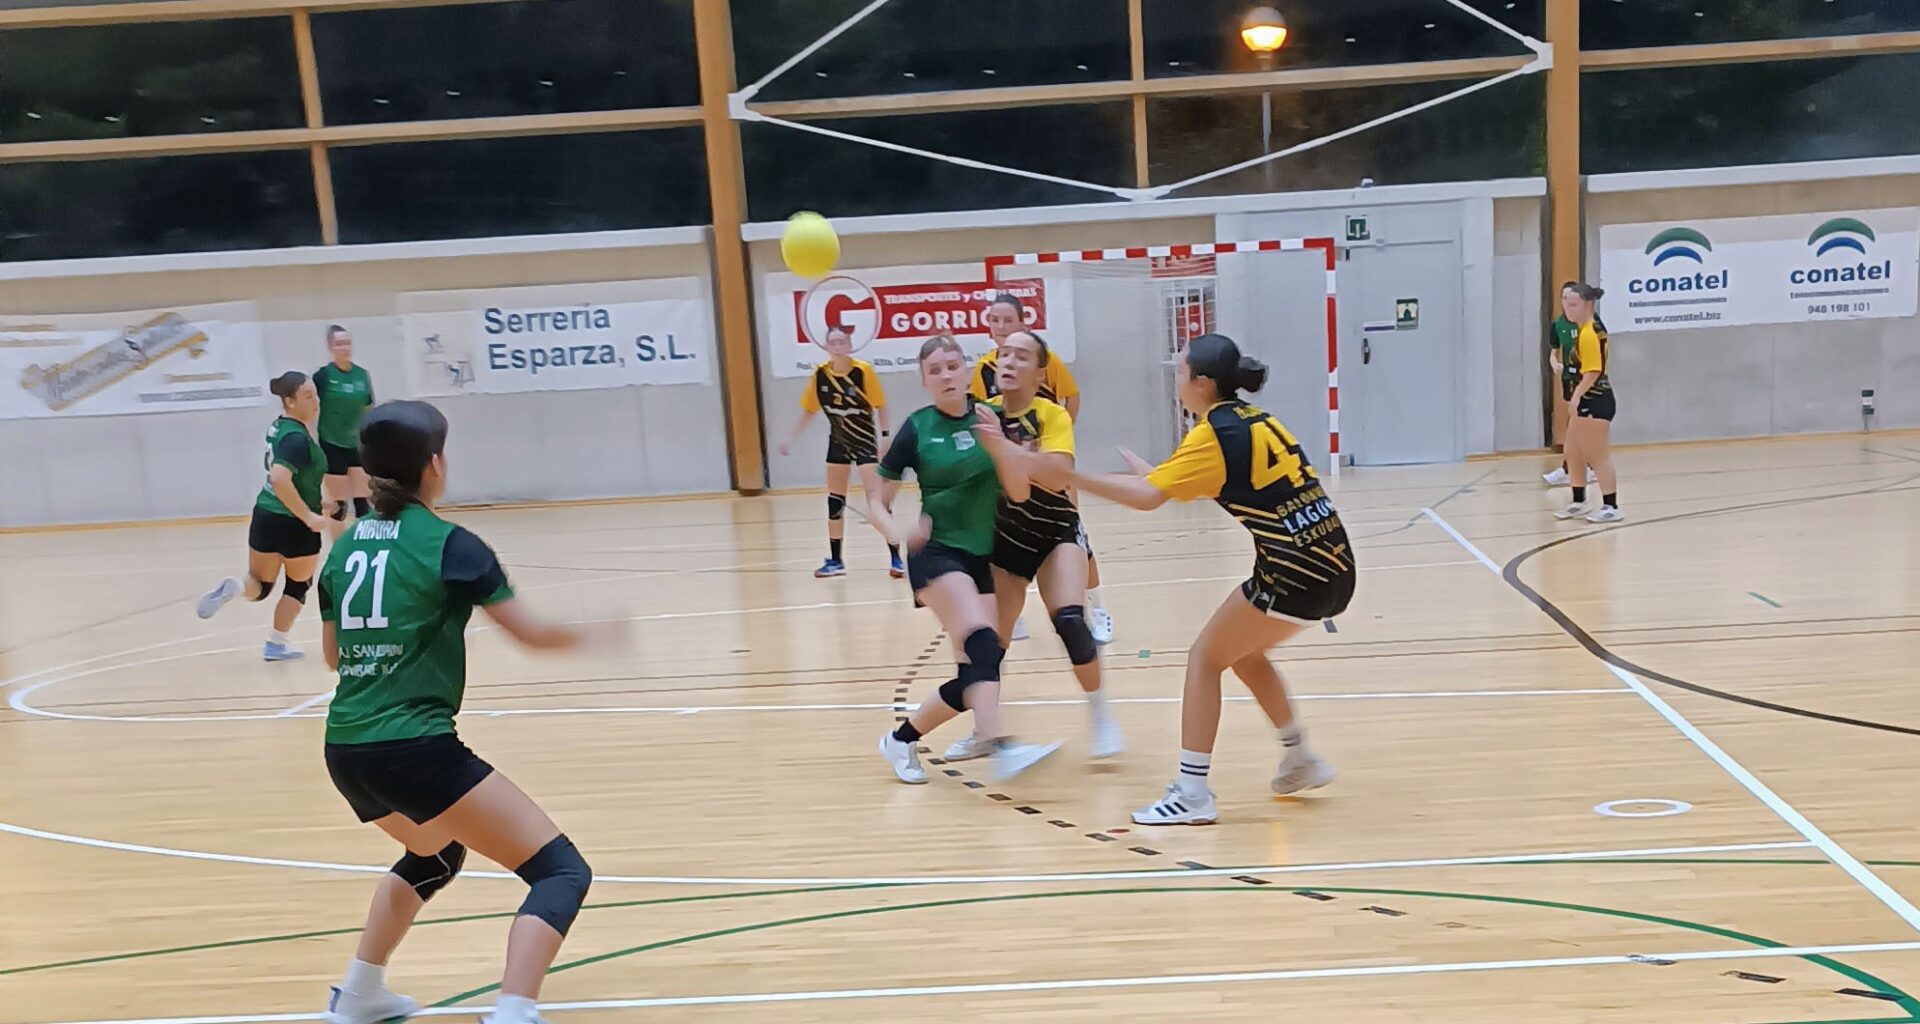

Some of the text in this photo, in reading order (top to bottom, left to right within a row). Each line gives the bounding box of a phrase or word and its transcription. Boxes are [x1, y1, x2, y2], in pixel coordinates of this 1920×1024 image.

[1628, 269, 1728, 294] conatel
[1790, 260, 1891, 284] conatel
[891, 306, 1038, 332] GORRICO
[1808, 304, 1828, 314] 948
[488, 334, 697, 374] Esparza, S.L.
[341, 549, 390, 630] 21
